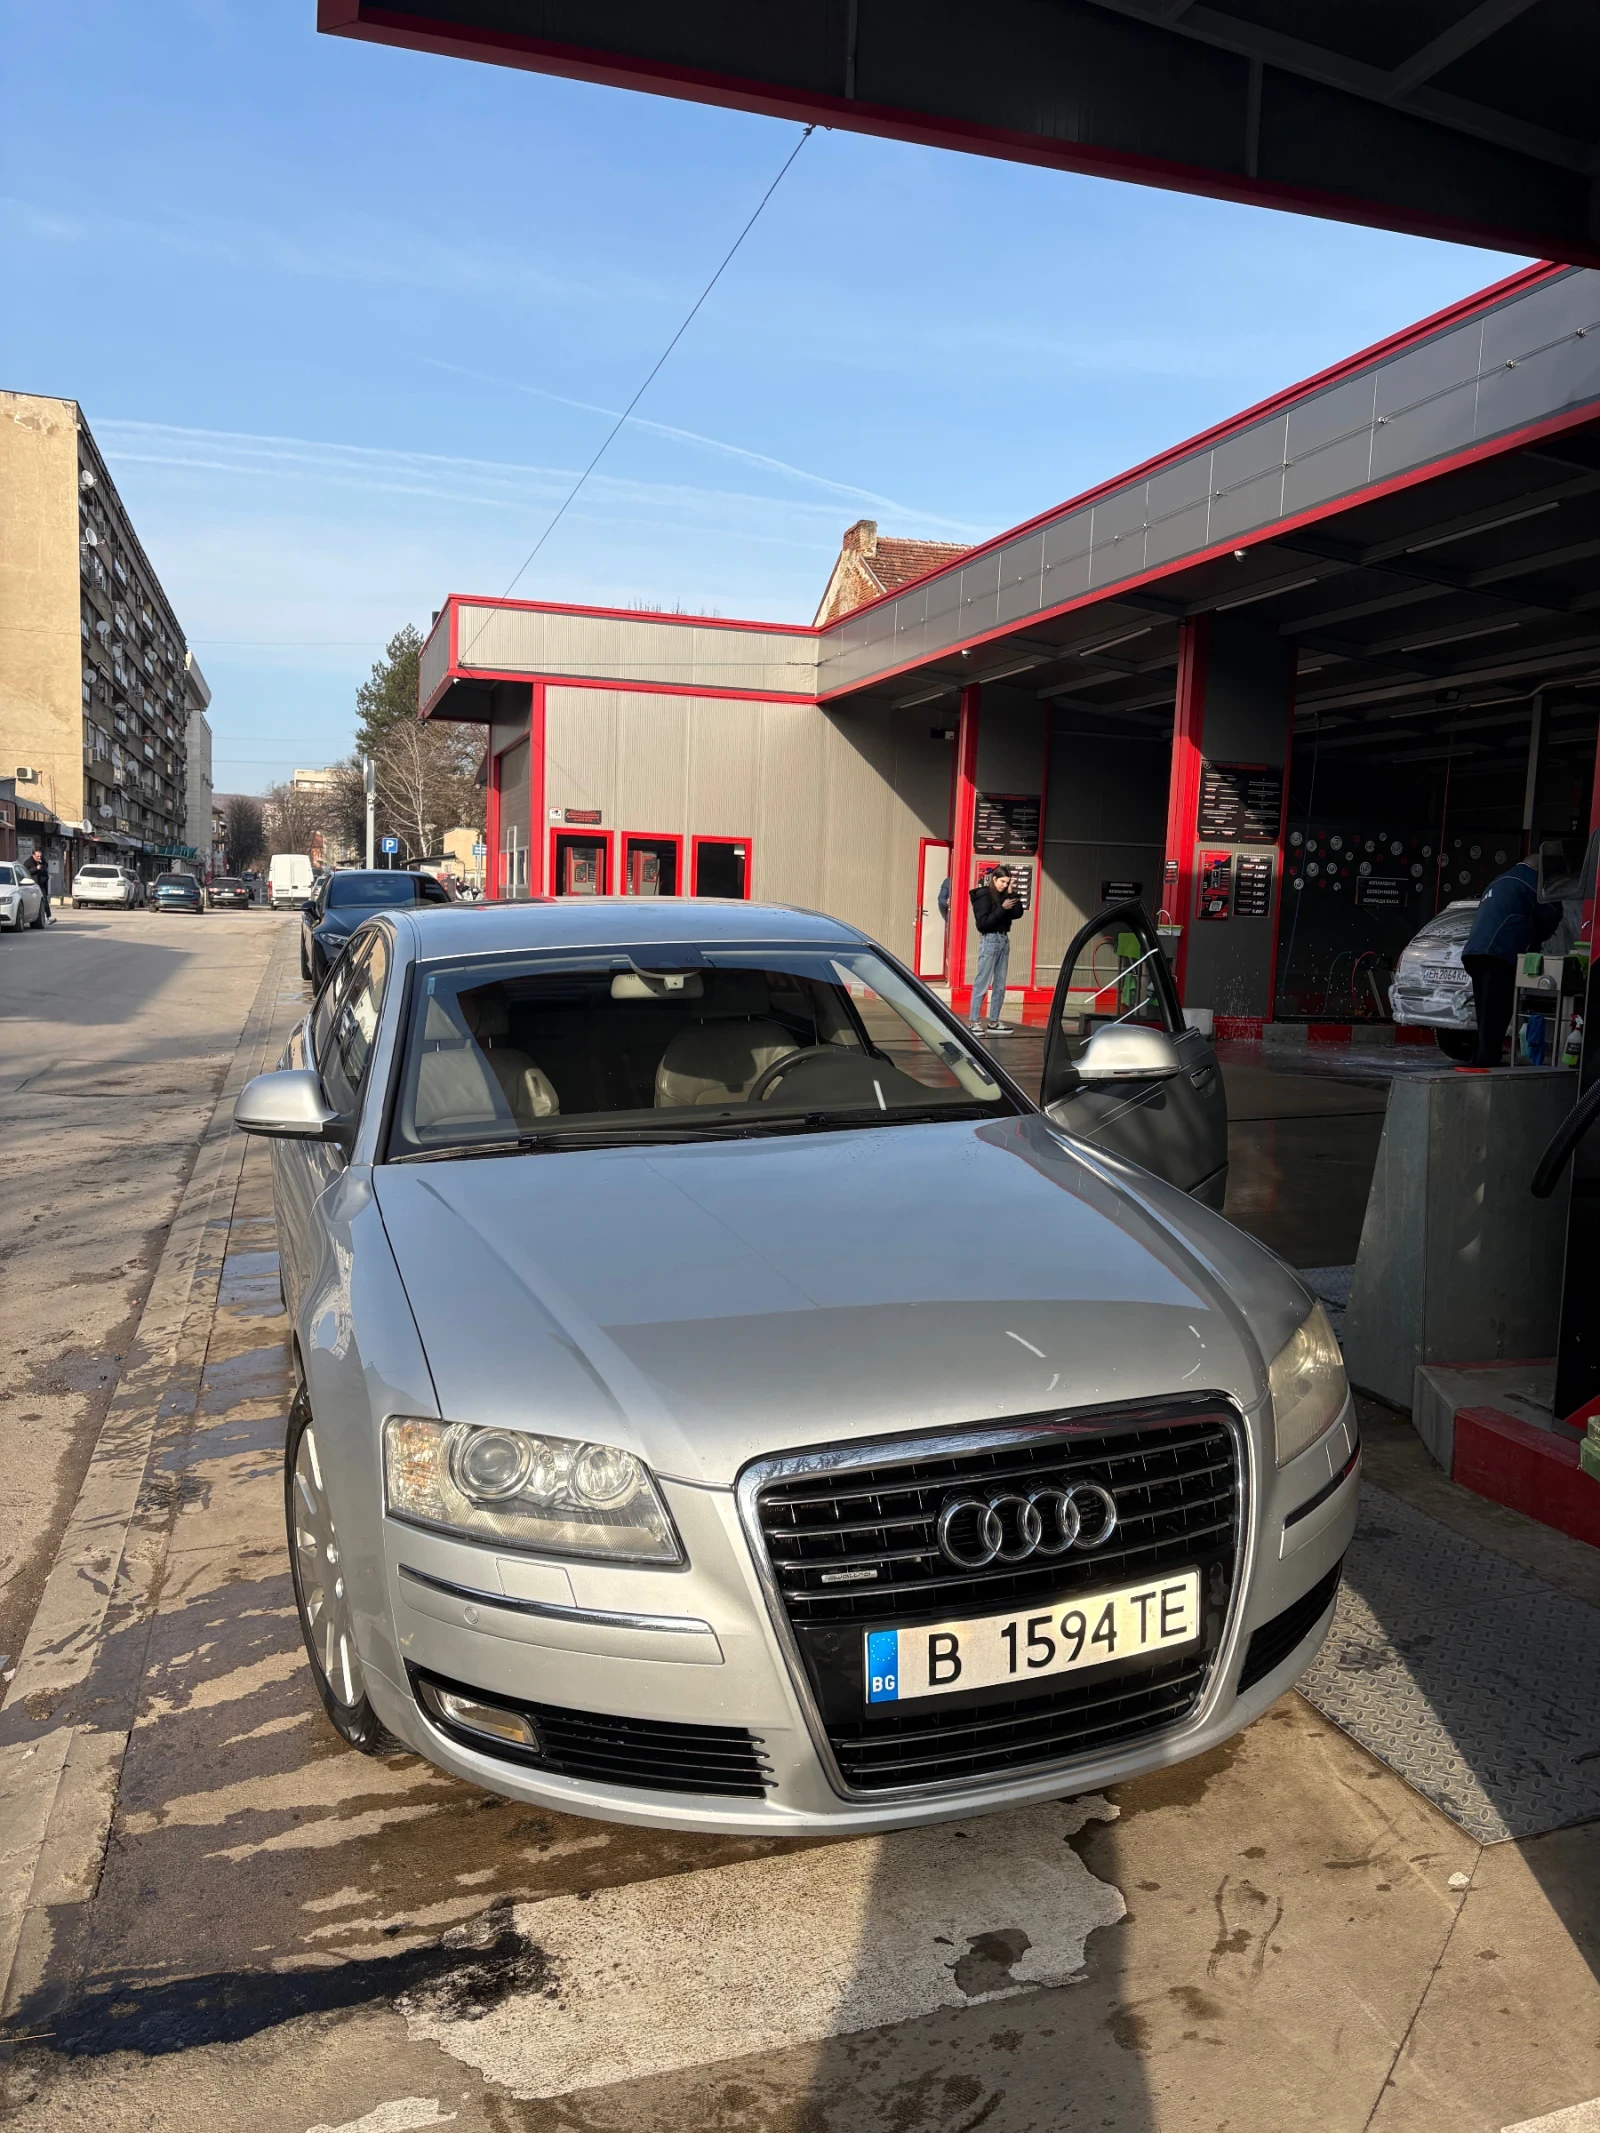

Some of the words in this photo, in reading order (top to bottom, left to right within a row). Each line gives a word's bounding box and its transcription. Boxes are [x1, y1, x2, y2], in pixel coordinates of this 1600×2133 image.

[386, 840, 395, 851] P
[1439, 969, 1456, 980] 2064
[927, 1633, 962, 1687] B
[1000, 1602, 1118, 1675] 1594
[1130, 1584, 1188, 1645] TE
[872, 1675, 896, 1693] BG
